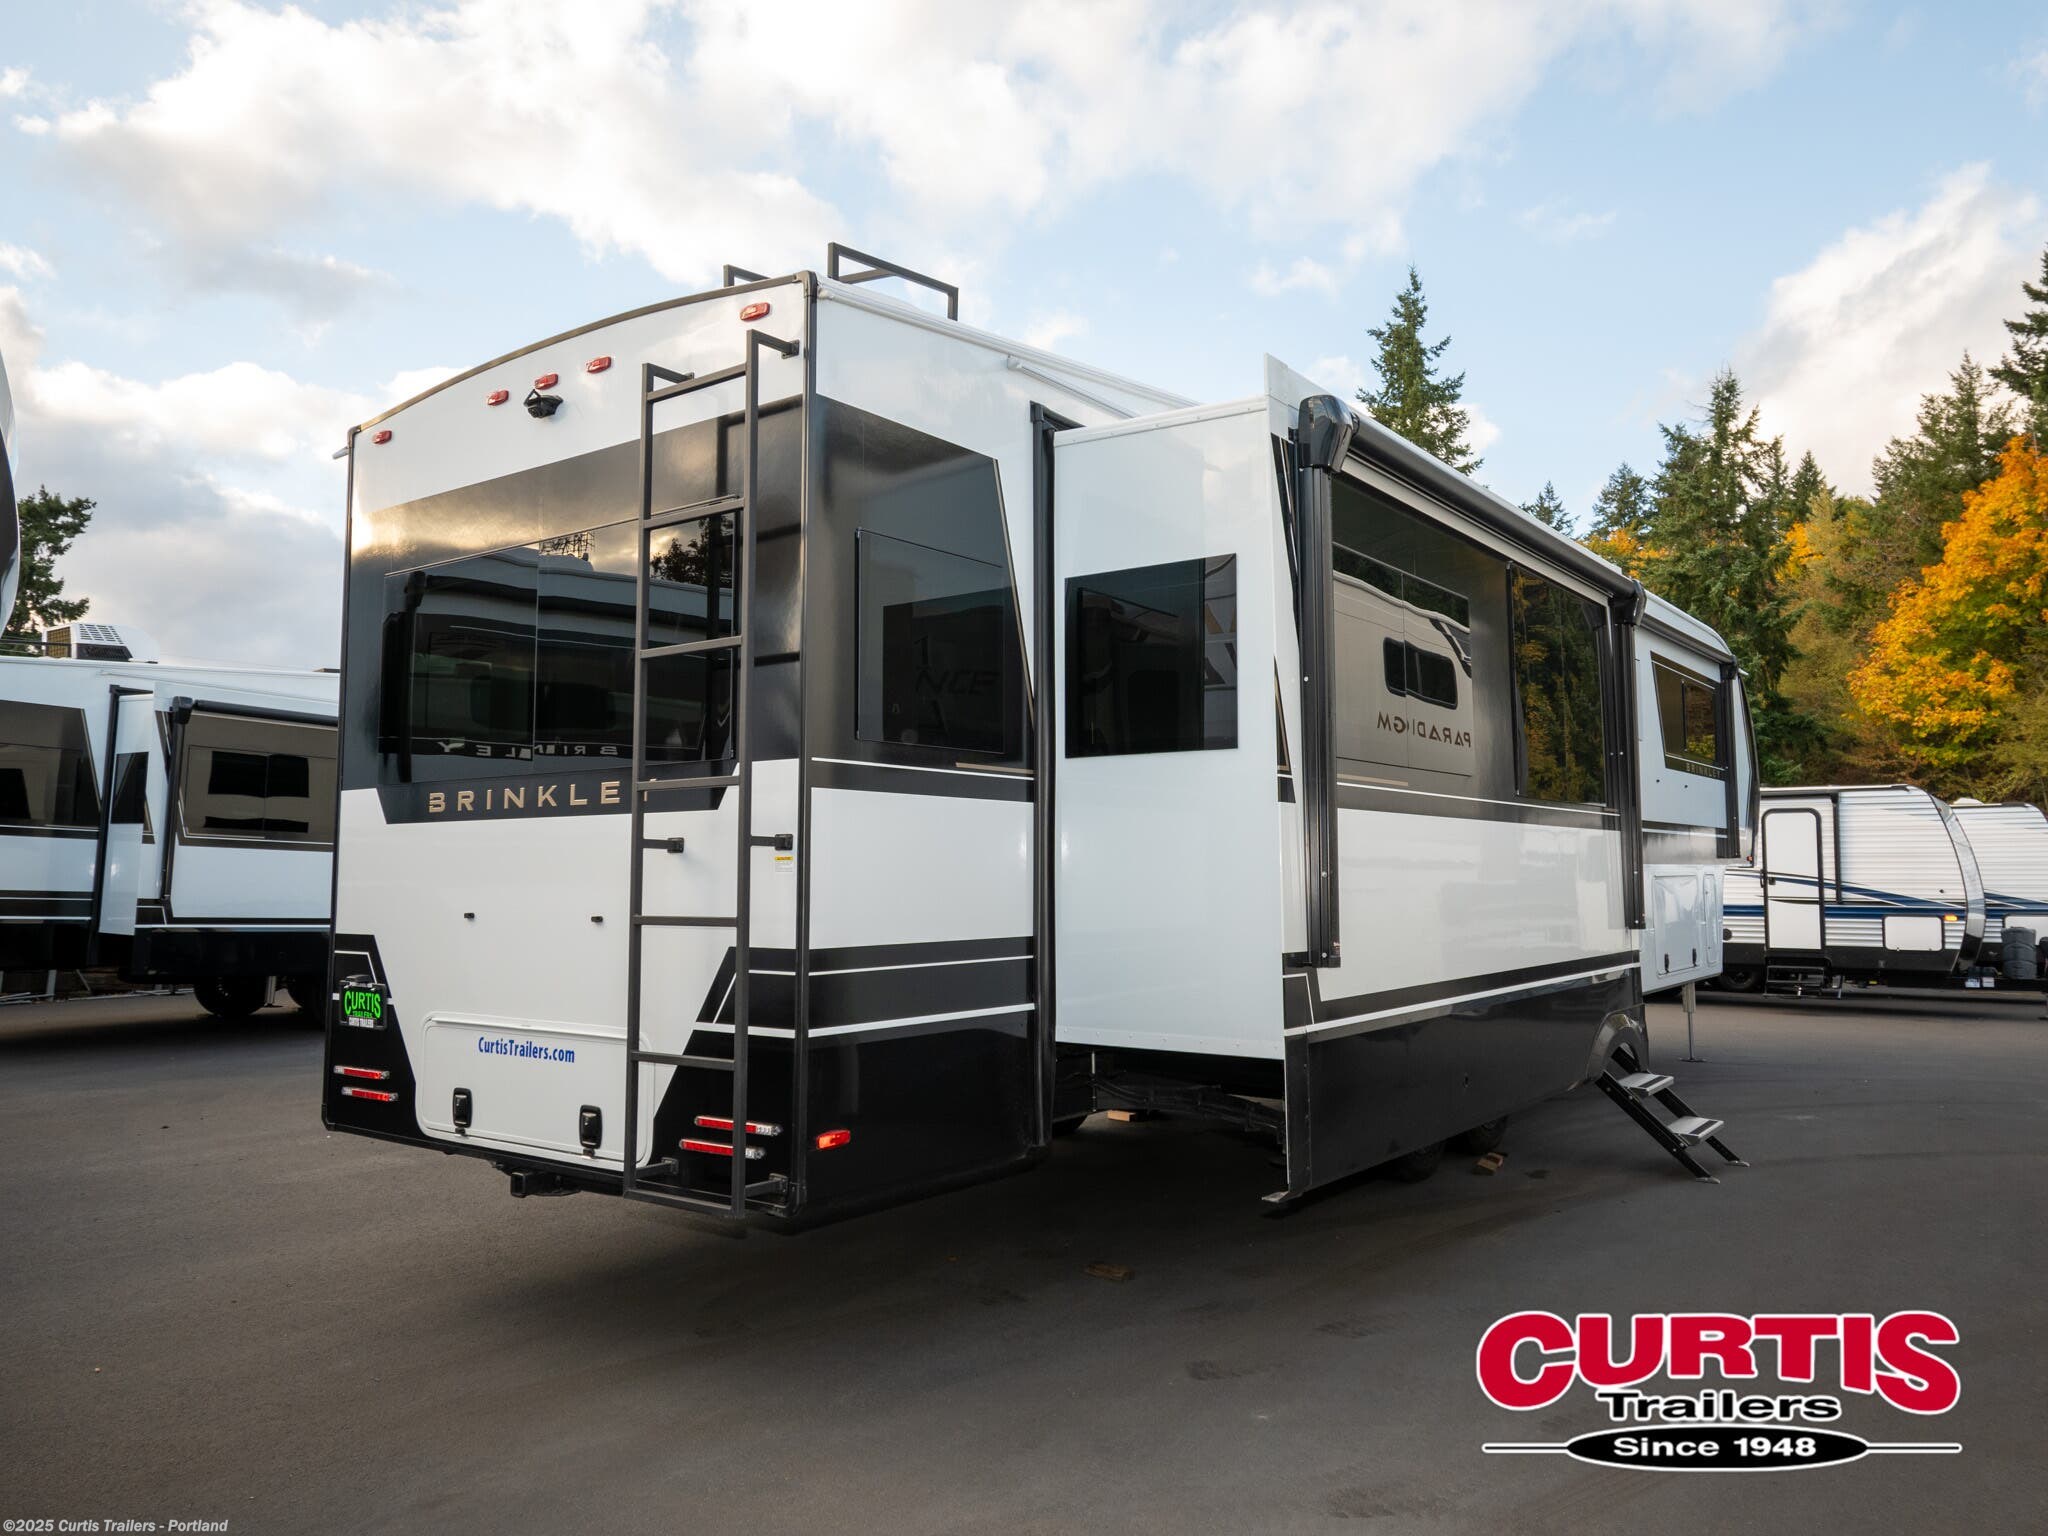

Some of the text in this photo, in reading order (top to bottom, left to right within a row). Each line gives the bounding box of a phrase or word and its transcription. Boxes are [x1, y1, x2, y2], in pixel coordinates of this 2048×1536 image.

[428, 778, 657, 813] BRINKLE
[344, 990, 381, 1019] CURTIS
[478, 1036, 575, 1063] CurtisTrailers.com
